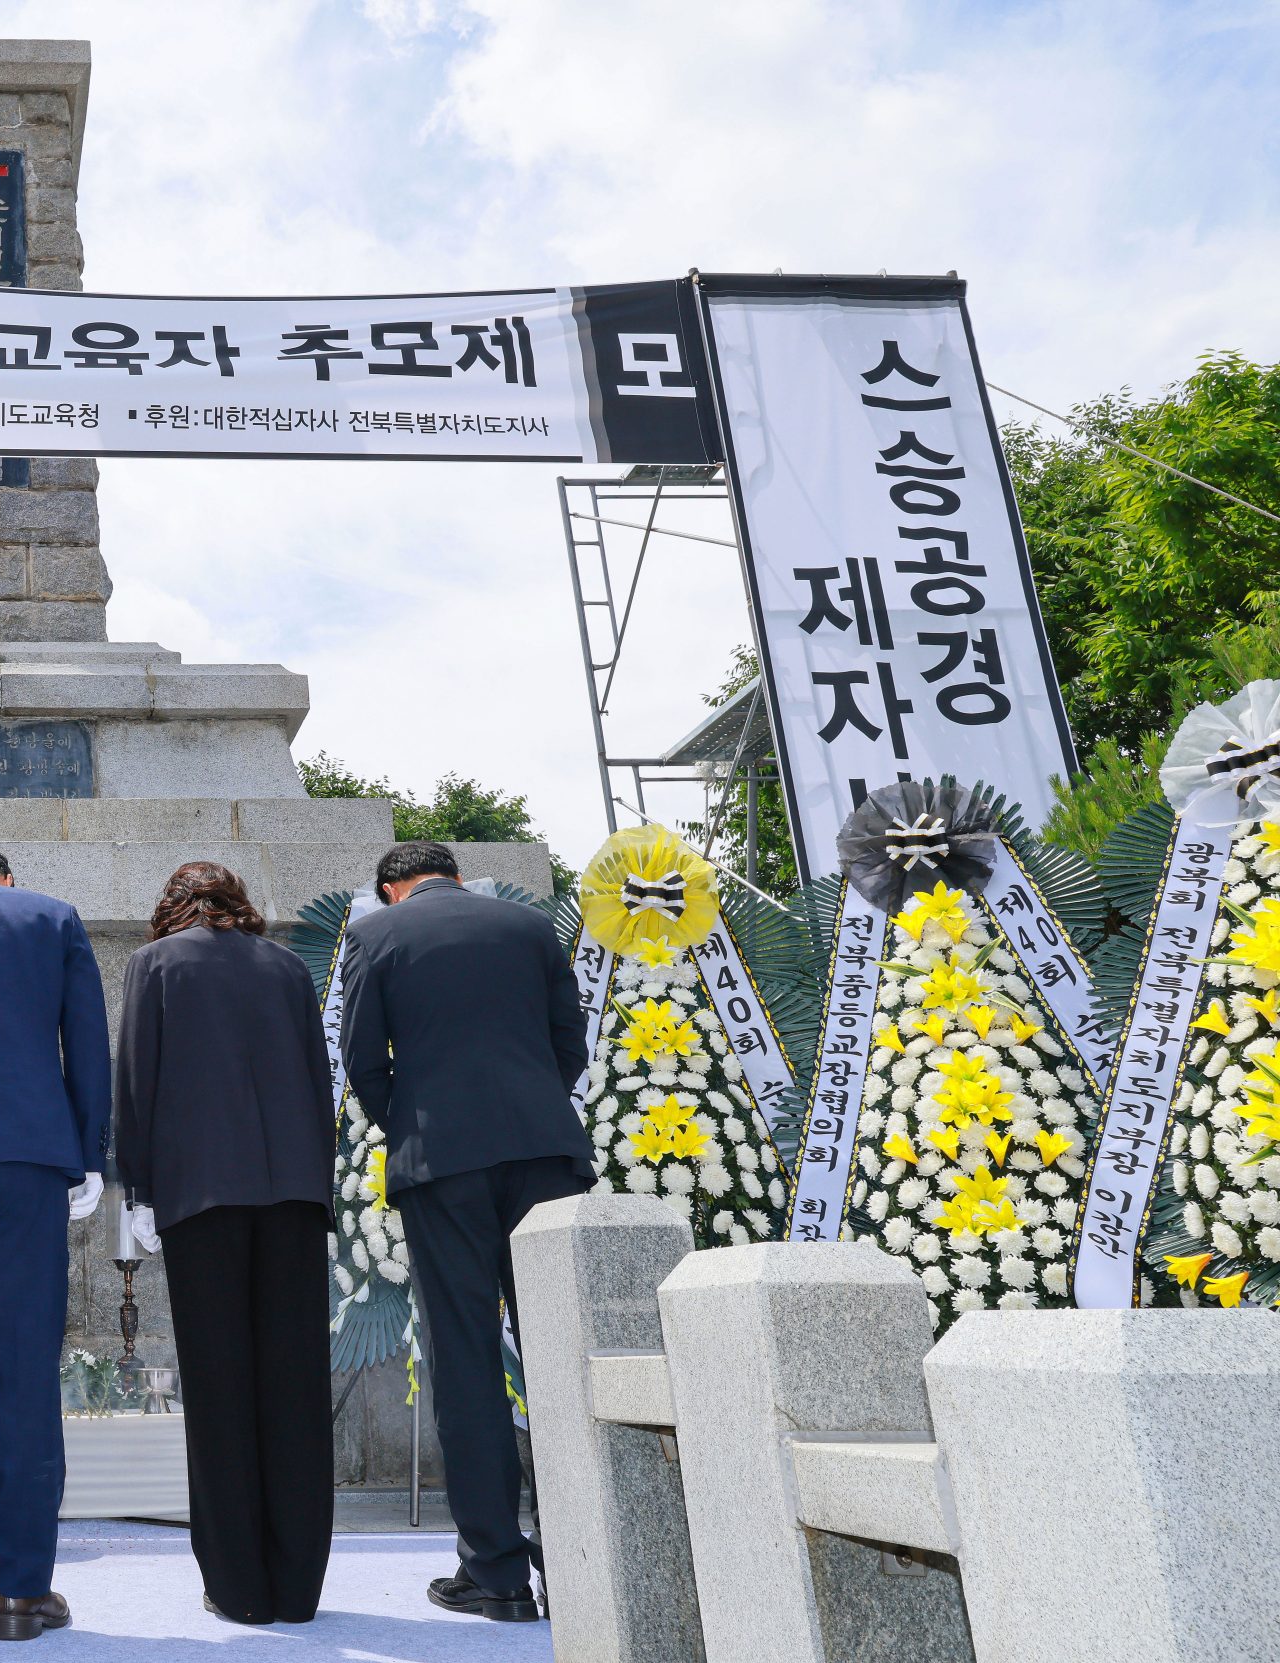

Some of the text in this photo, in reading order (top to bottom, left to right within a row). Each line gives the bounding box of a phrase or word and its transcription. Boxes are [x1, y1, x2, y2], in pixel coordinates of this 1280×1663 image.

[276, 316, 538, 388] 추모제
[616, 332, 697, 398] 모
[144, 404, 550, 437] 후원:대한적십자사 전북특별자치도지사
[860, 340, 1012, 726] 스승공경
[793, 556, 915, 813] 제자
[695, 932, 768, 1057] 제40회
[995, 884, 1077, 988] 제40회
[804, 914, 877, 1172] 전북중등교장협의회
[1087, 842, 1224, 1260] 광복회 전북특별자치도지부장 이강안
